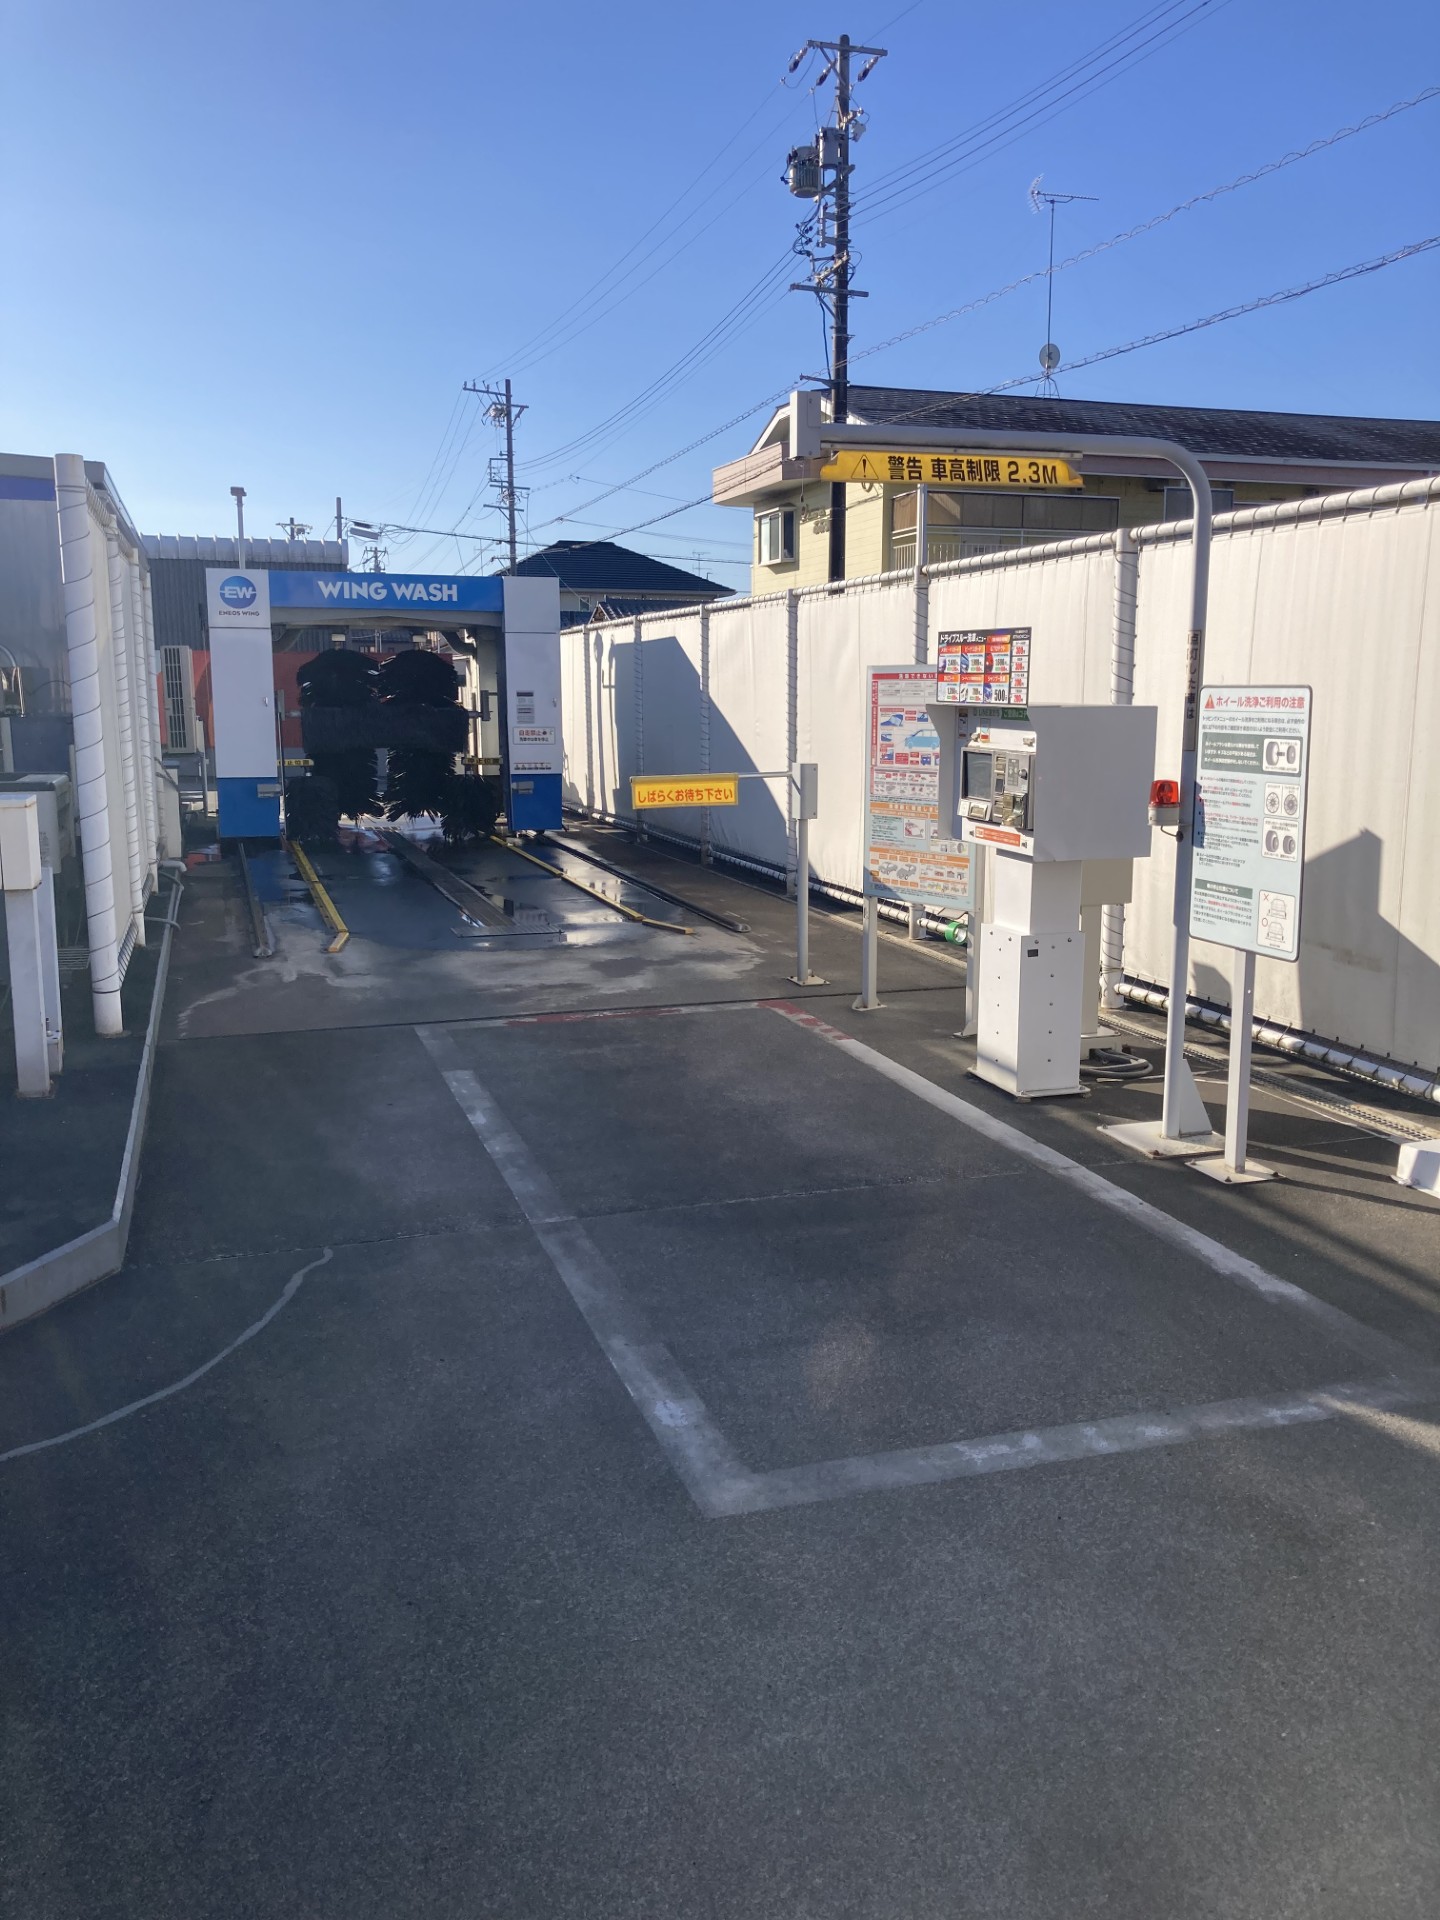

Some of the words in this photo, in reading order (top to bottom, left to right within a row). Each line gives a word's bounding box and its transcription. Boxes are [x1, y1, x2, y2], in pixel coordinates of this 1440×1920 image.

[888, 455, 923, 481] 警告
[931, 457, 1001, 482] 車高制限
[1007, 461, 1058, 484] 2.3M
[317, 581, 387, 600] WING
[391, 583, 458, 602] WASH
[1216, 696, 1305, 709] ホイール洗浄ご利用の注意
[637, 787, 733, 803] しばらくお待ち下さい
